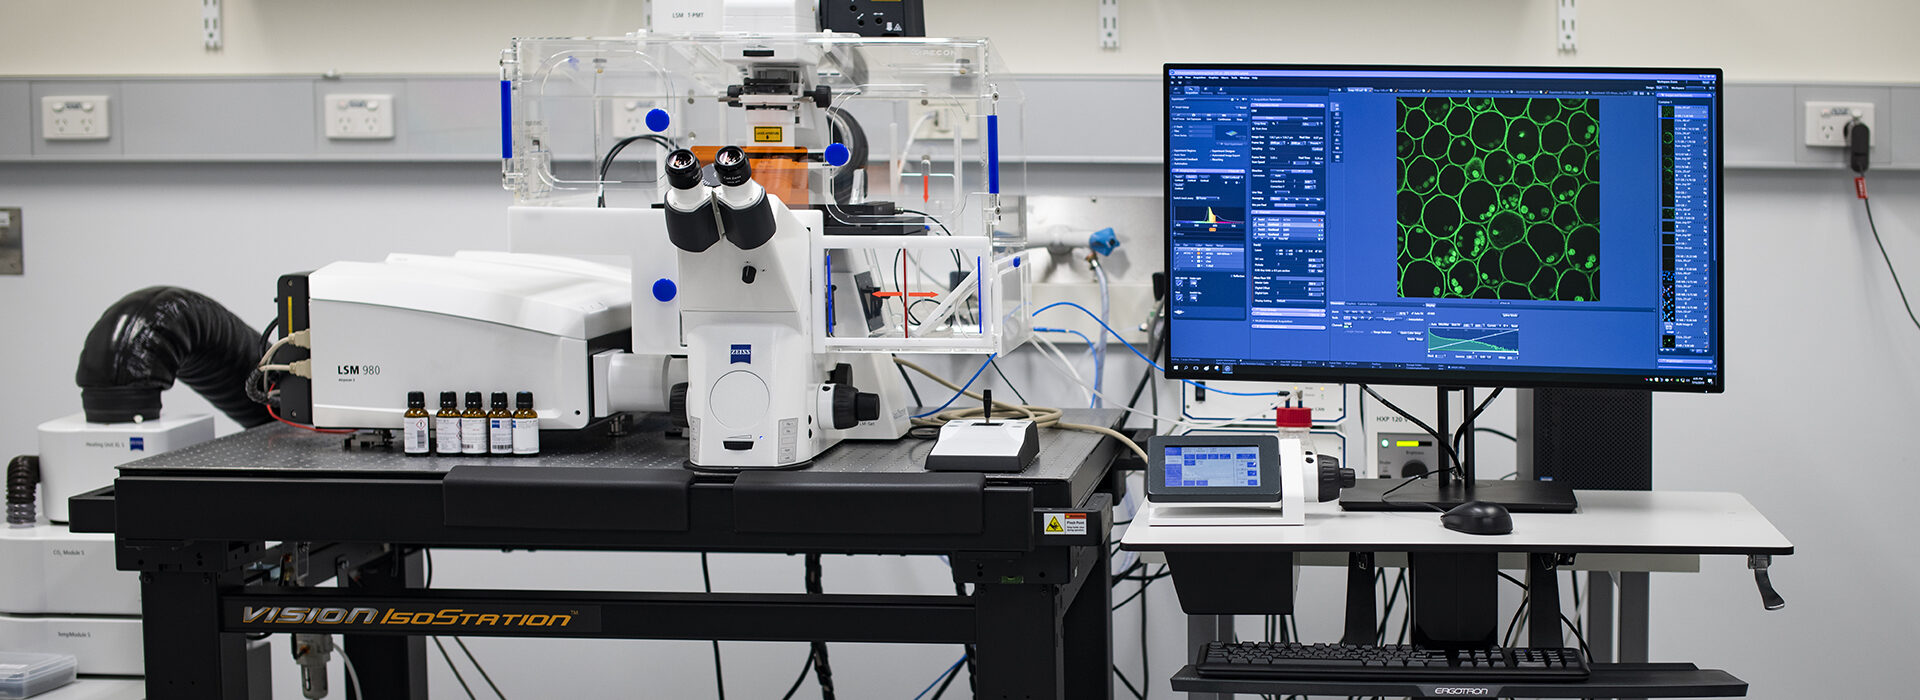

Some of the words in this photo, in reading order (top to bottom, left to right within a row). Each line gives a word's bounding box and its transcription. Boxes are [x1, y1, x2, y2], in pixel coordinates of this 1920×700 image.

[338, 365, 359, 375] LSM
[362, 365, 380, 375] 980
[242, 606, 379, 625] VISION
[1434, 687, 1489, 695] ERGOTRON
